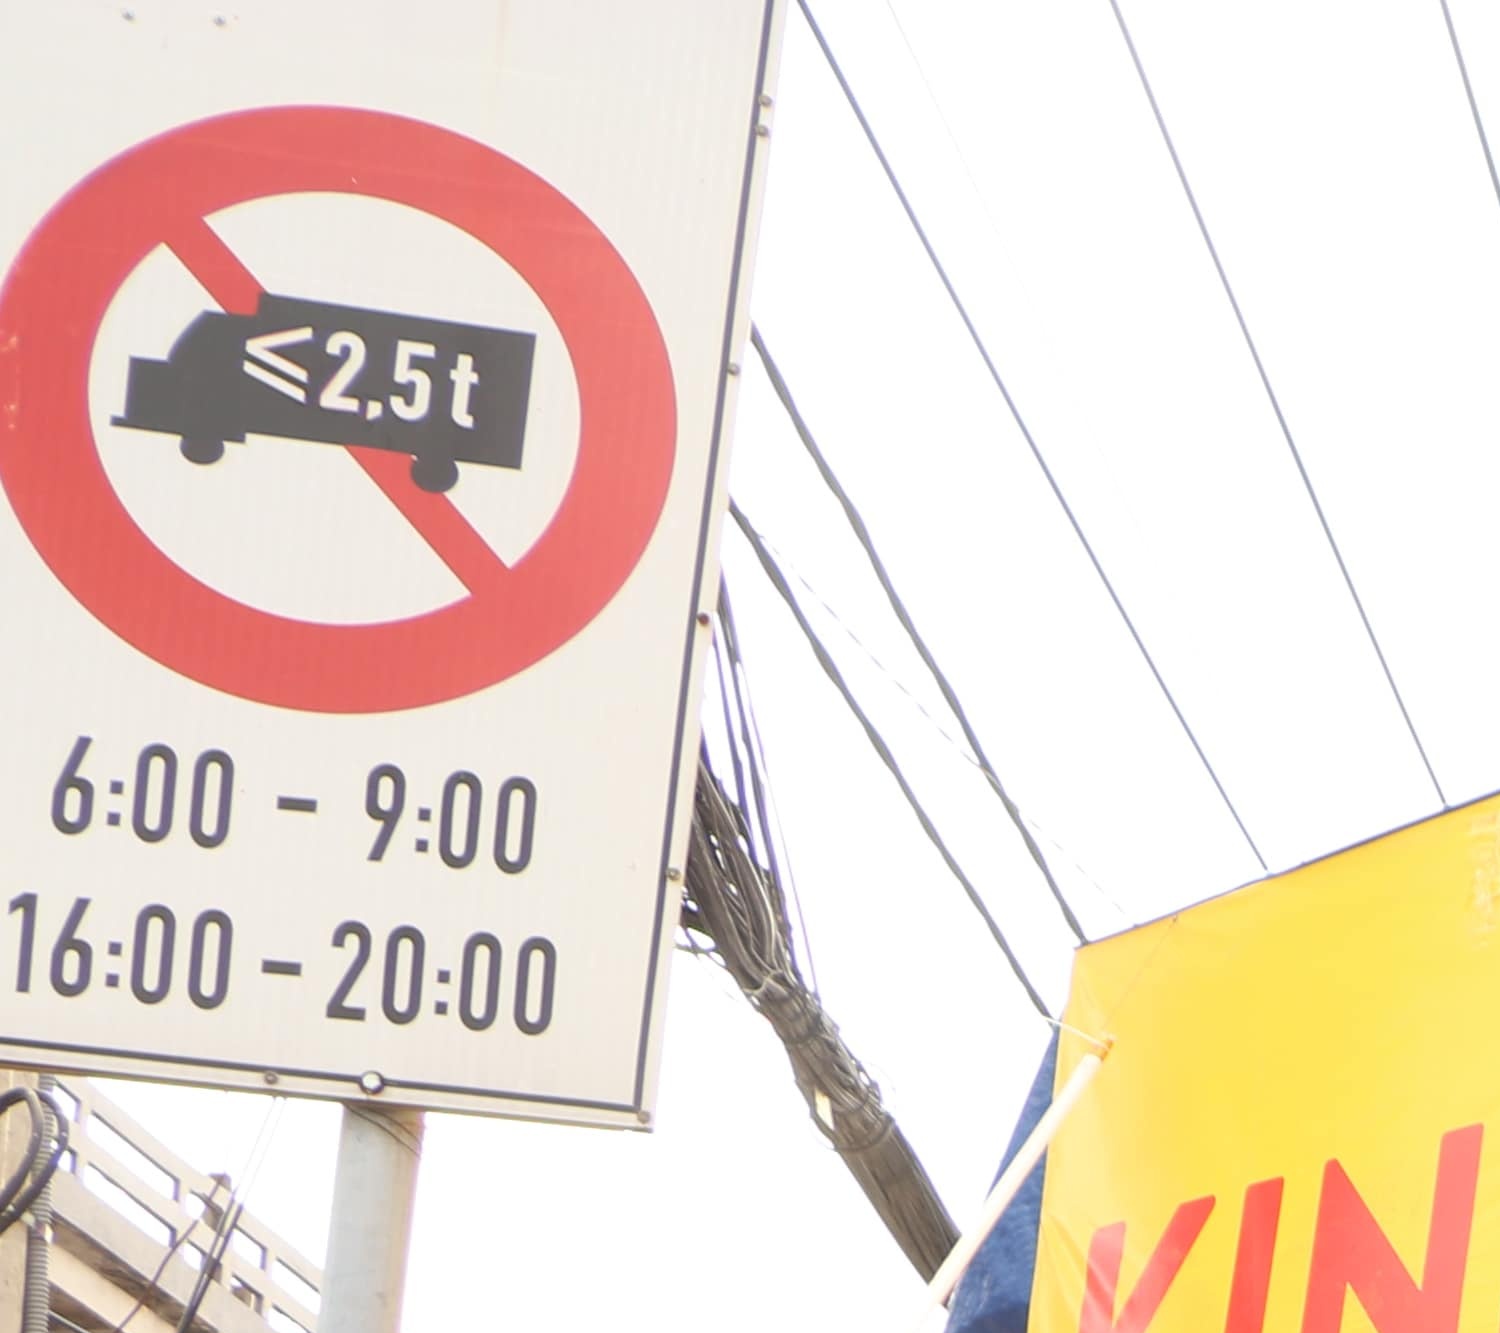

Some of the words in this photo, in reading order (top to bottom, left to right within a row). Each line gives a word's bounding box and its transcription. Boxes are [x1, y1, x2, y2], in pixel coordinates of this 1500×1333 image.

[51, 736, 235, 848] 6:00
[364, 763, 538, 875] 9:00
[4, 892, 233, 1010] 16:00
[325, 920, 557, 1036] 20:00
